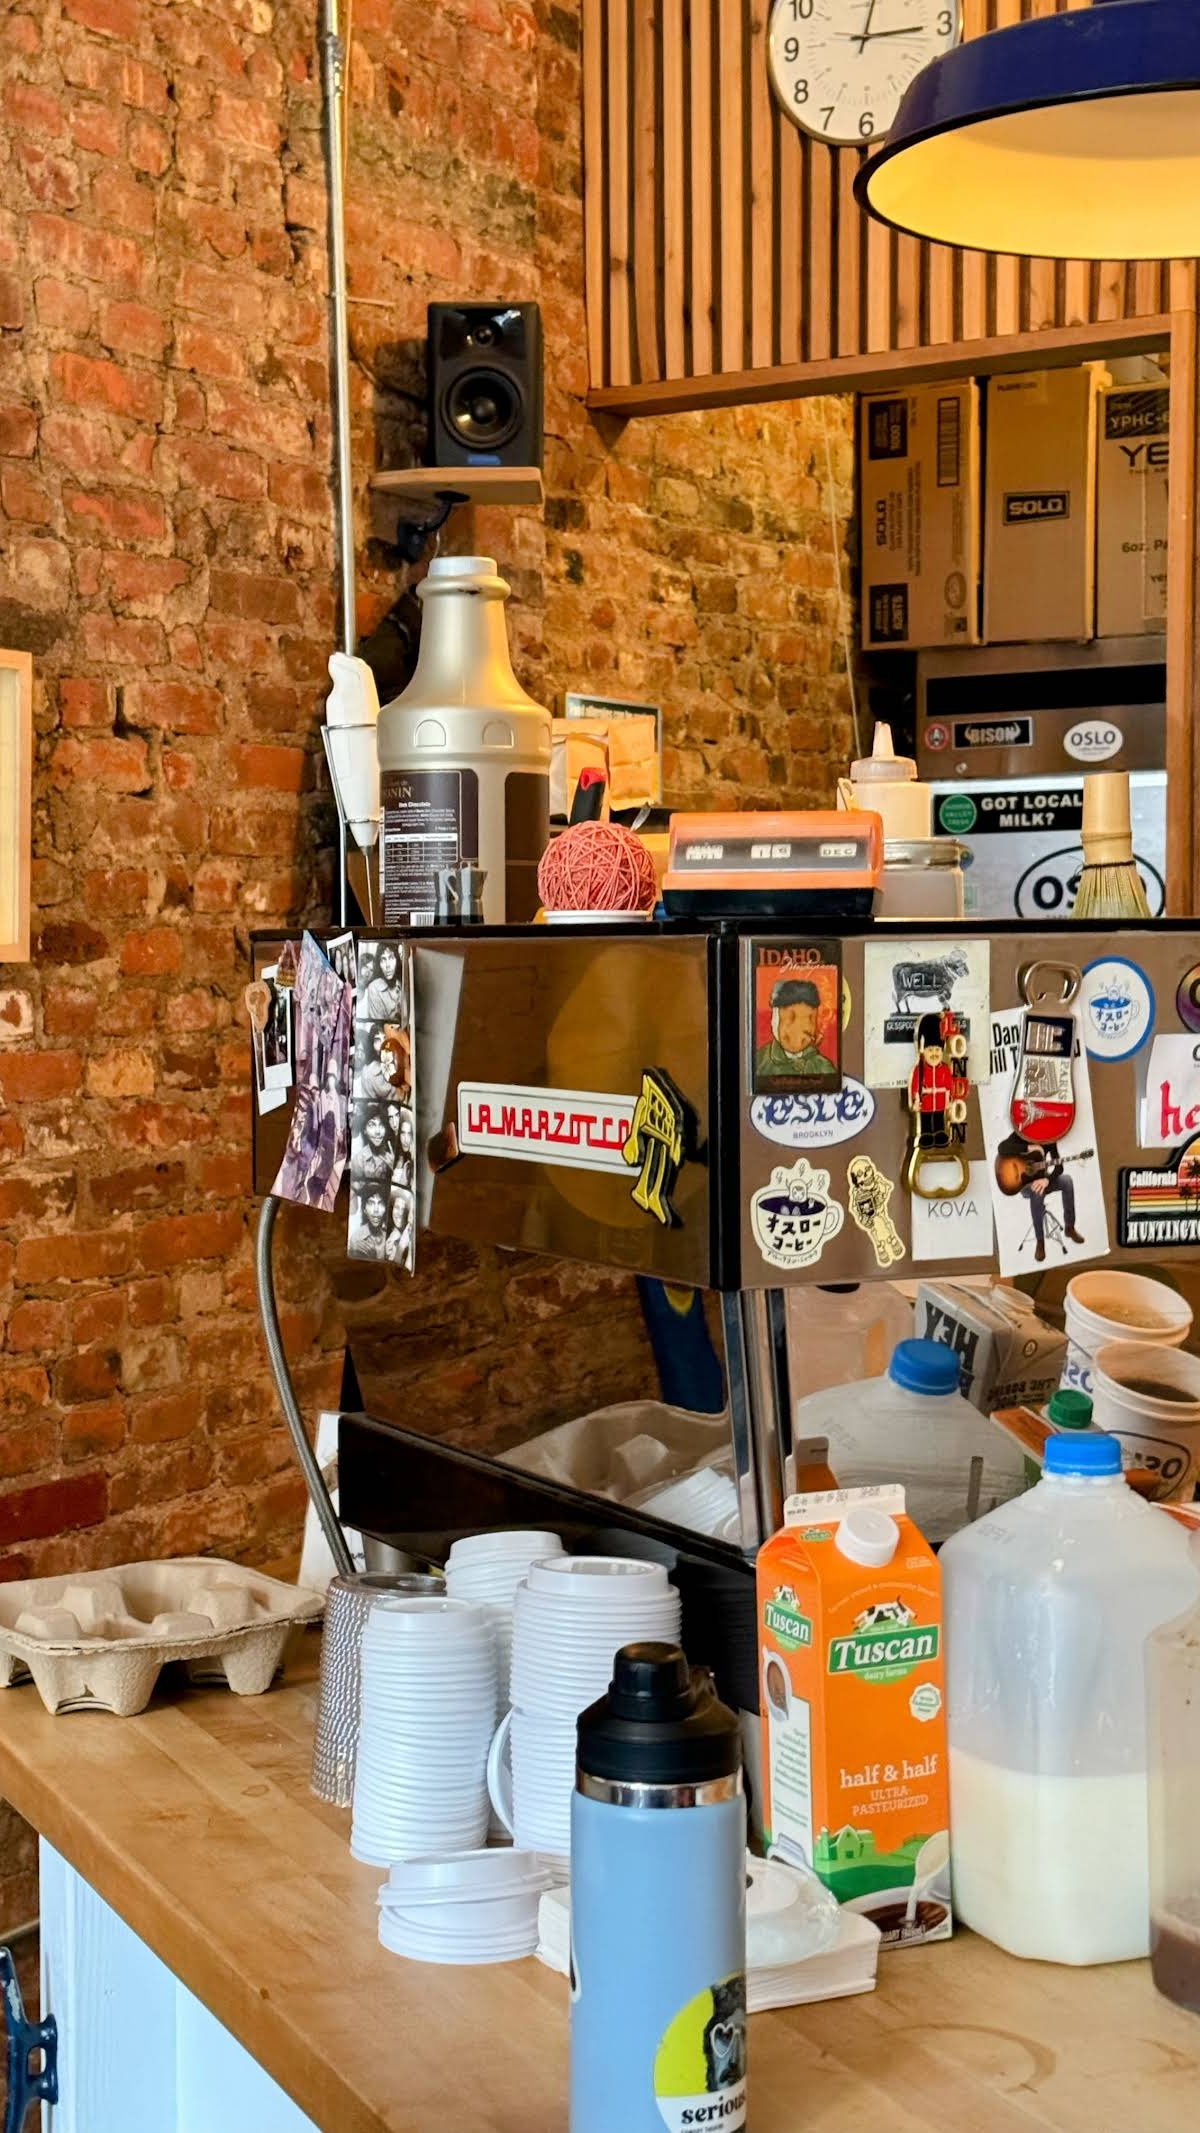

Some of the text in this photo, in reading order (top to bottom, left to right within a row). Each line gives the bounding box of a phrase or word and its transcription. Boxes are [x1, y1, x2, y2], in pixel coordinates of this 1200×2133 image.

[936, 10, 953, 36] 3
[784, 37, 799, 62] 9
[793, 79, 809, 104] 8
[819, 106, 835, 132] 7
[858, 112, 874, 137] 6
[1119, 442, 1169, 468] YE
[1008, 498, 1065, 517] SOLO
[876, 500, 888, 546] SOLO
[1070, 730, 1116, 746] OSLO
[981, 793, 1083, 811] GOT LOCAL
[998, 812, 1056, 828] MILK?
[759, 947, 821, 966] IDAHO
[901, 972, 942, 989] WELL
[1059, 1061, 1069, 1100] PARIS
[792, 1130, 834, 1140] BROOKLYN
[1129, 1171, 1178, 1188] California
[928, 1201, 978, 1218] KOVA
[765, 1604, 809, 1642] Tuscan
[833, 1632, 934, 1671] Tuscan
[839, 1754, 938, 1789] half & half
[852, 1794, 929, 1816] PASTEURIZED
